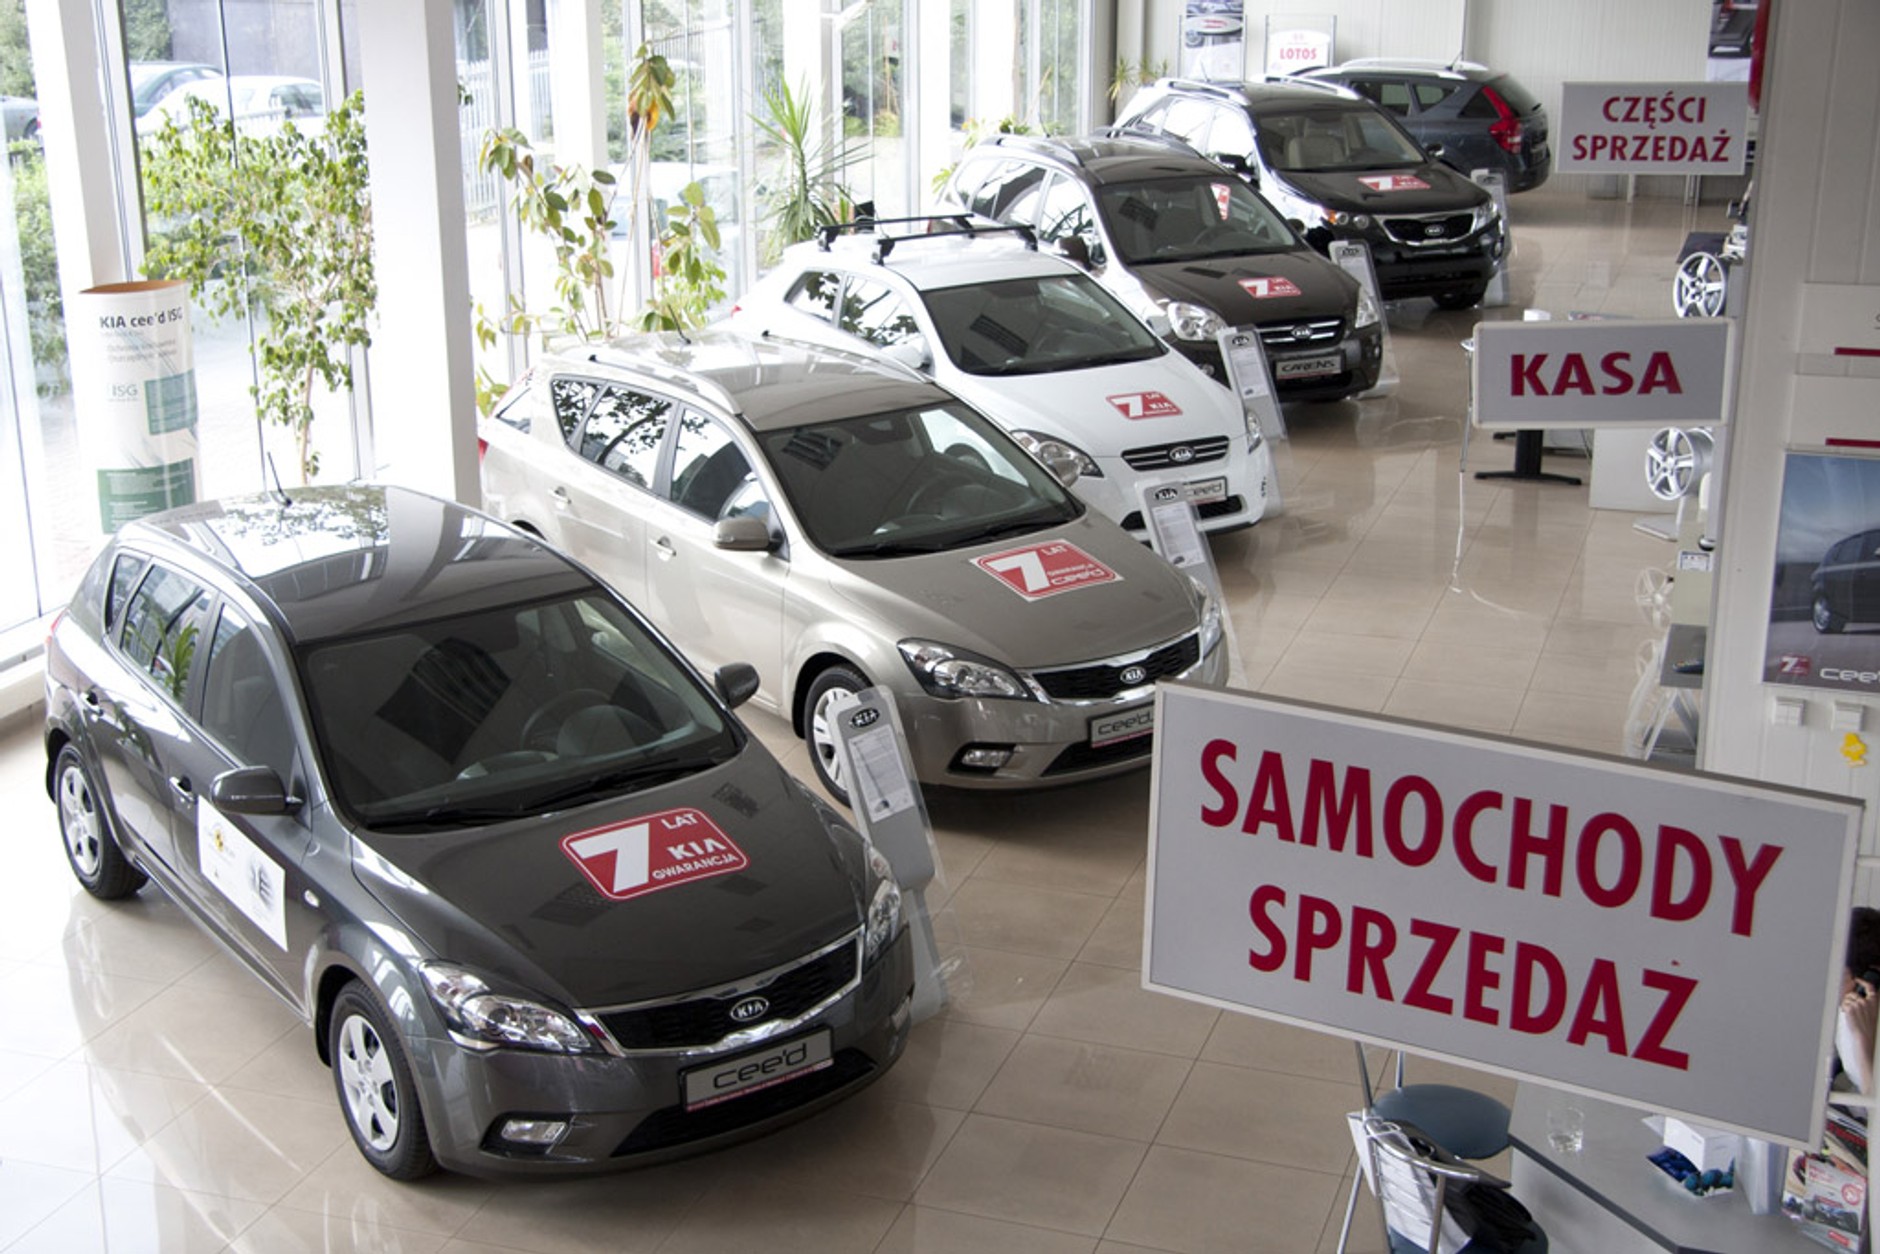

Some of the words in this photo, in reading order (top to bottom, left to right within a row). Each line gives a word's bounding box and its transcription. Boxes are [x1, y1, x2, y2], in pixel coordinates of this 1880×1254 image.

[1279, 47, 1317, 60] LOTOS
[1602, 91, 1707, 130] CZĘŚCI
[1572, 128, 1731, 163] SPRZEDAŻ
[99, 315, 127, 329] KIA
[130, 310, 167, 328] cee'd
[1281, 358, 1335, 373] CARENS
[1510, 351, 1683, 397] KASA
[112, 384, 138, 398] ISG
[1111, 394, 1144, 418] 7
[986, 550, 1051, 593] 7
[1123, 667, 1143, 681] KIA
[1780, 655, 1799, 673] 7
[853, 708, 878, 727] KIA
[660, 812, 699, 830] LAT
[667, 837, 728, 861] KIA
[1201, 738, 1783, 937] SAMOCHODY
[568, 821, 650, 895] 7
[652, 853, 739, 881] GWARANCJA
[1248, 884, 1699, 1071] SPRZEDAŻ
[735, 1001, 765, 1020] KIA
[713, 1042, 807, 1090] cee'd
